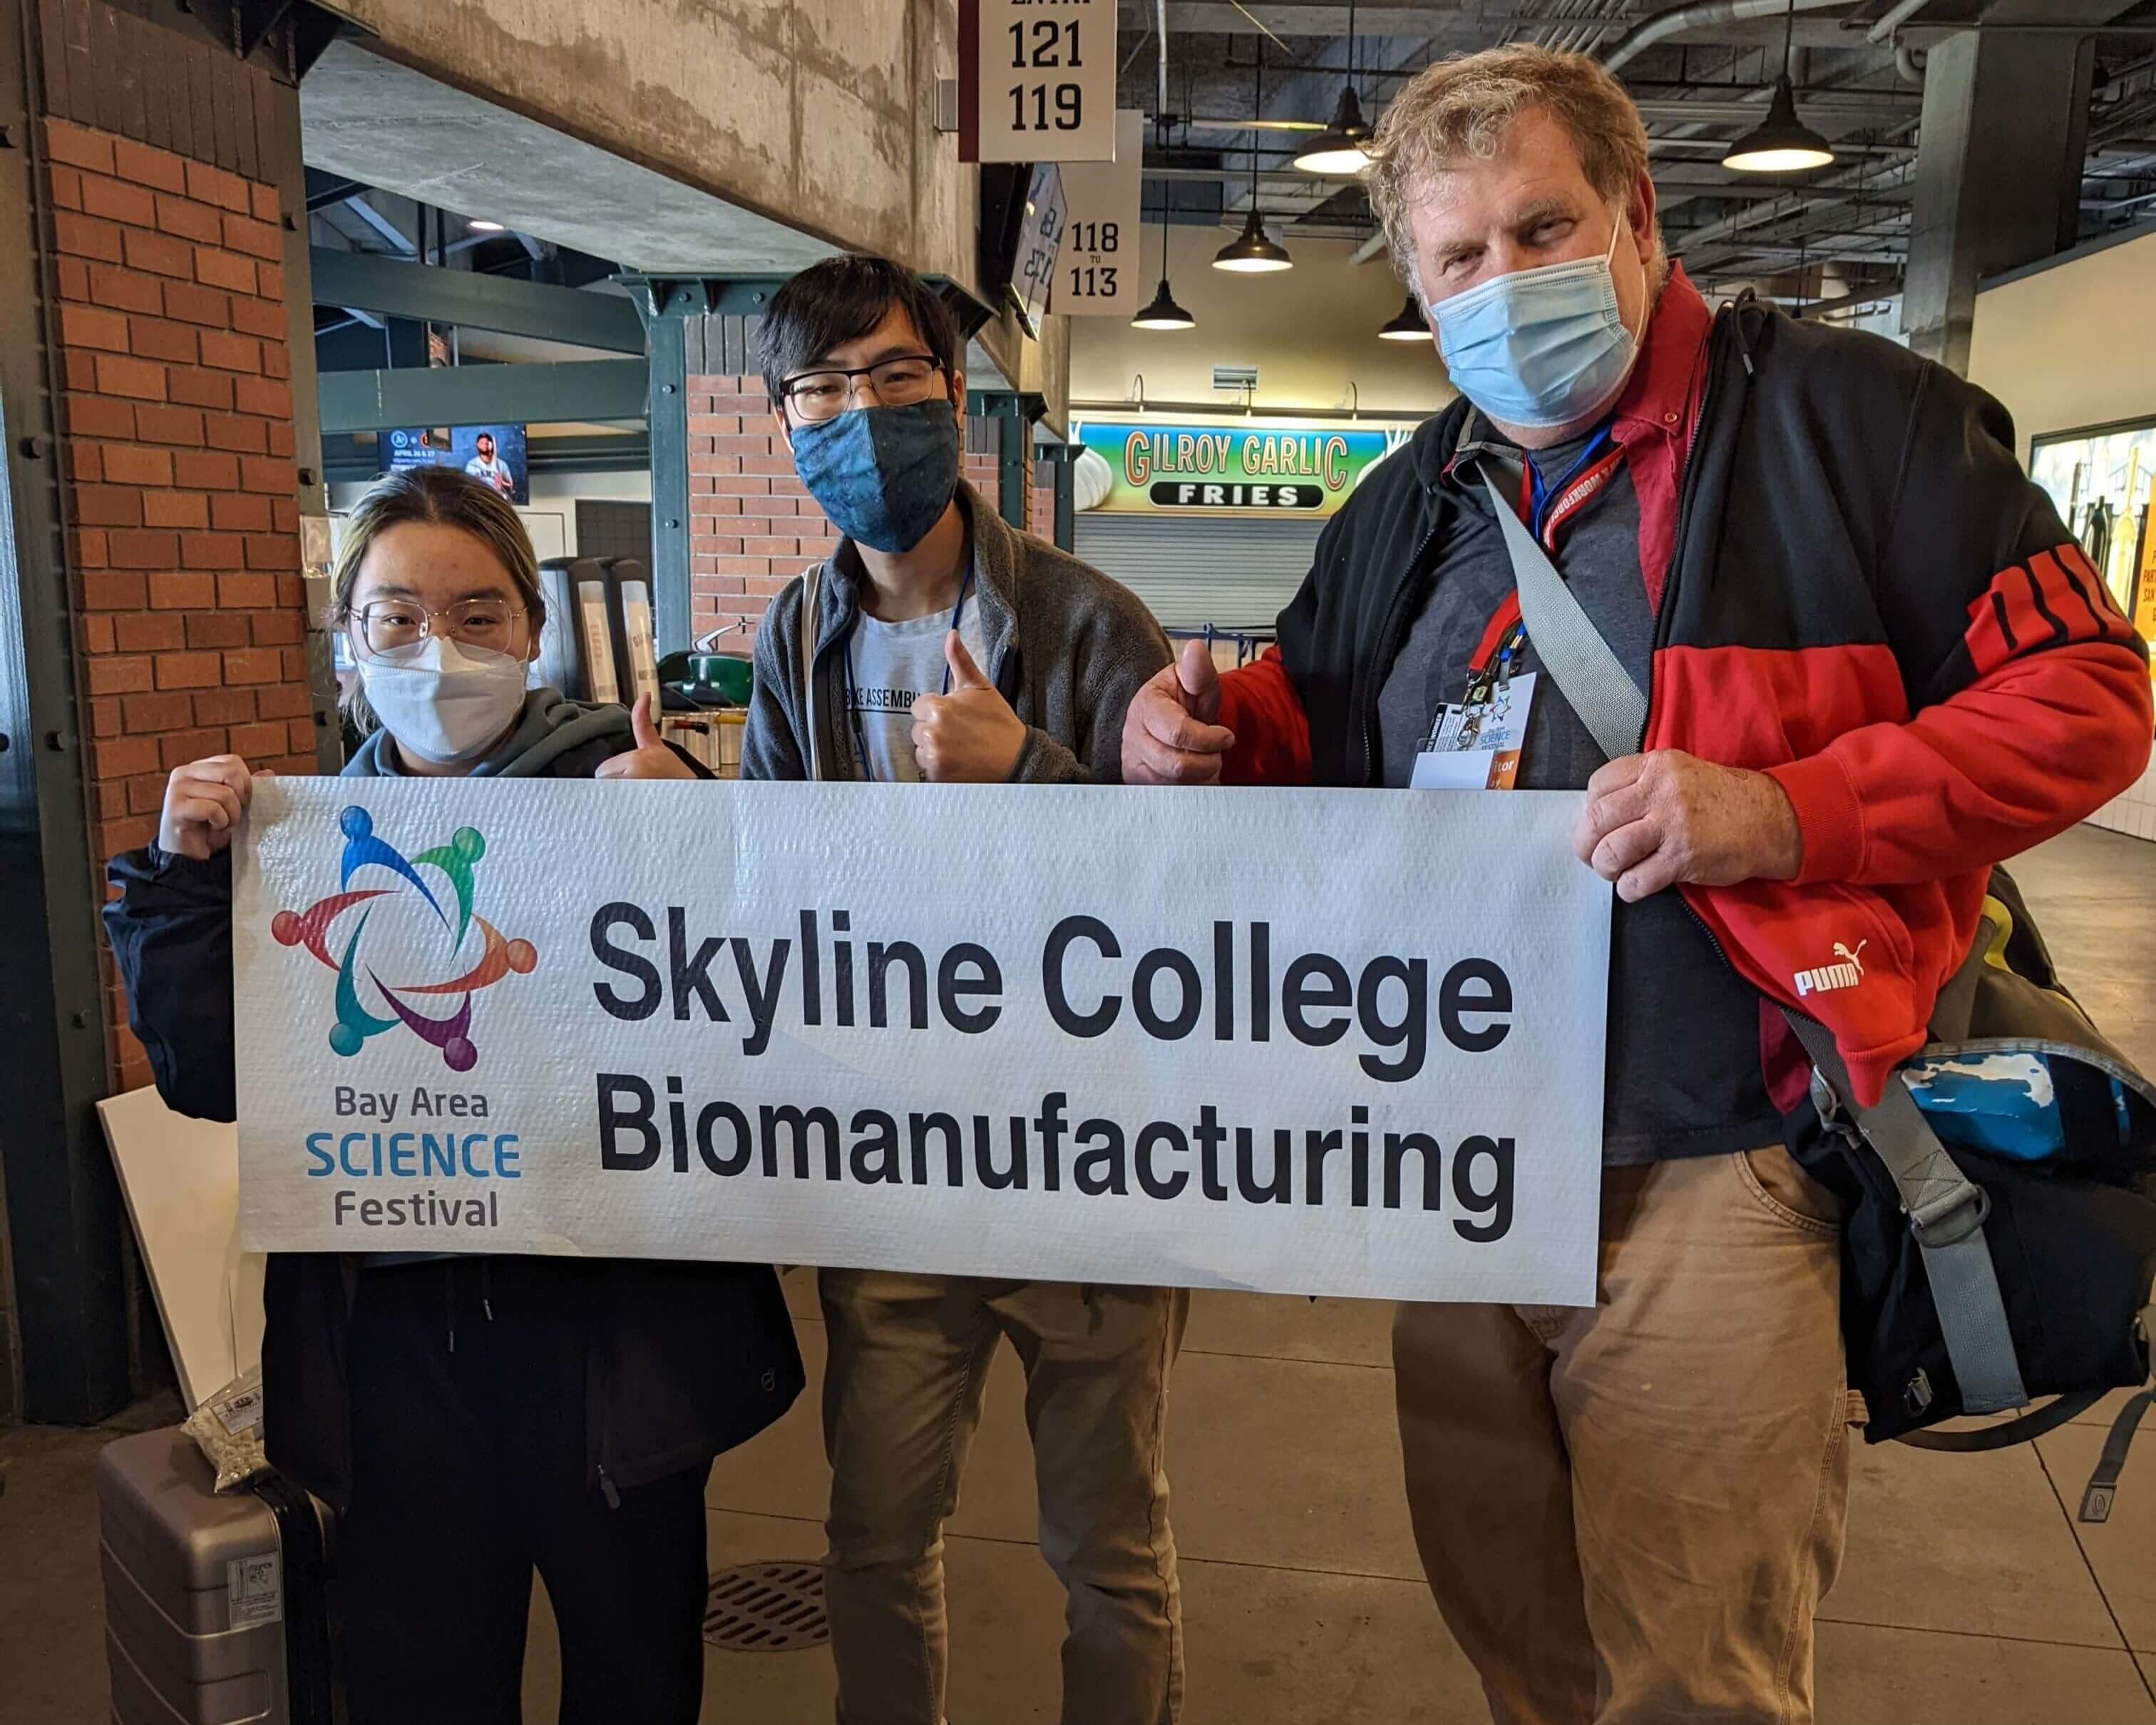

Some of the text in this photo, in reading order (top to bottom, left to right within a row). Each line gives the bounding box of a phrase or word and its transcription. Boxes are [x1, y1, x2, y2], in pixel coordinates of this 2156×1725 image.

[1009, 20, 1082, 68] 121
[1009, 83, 1082, 130] 119
[1071, 222, 1119, 252] 118
[1090, 255, 1101, 263] TO
[1070, 266, 1118, 297] 113
[1125, 430, 1348, 491] GILROY GARLIC
[1179, 484, 1298, 506] FRIES
[845, 688, 863, 706] BKE
[590, 901, 1513, 1082] Skyline College
[1794, 963, 1859, 996] PUMA
[335, 1085, 489, 1124] Bay Area
[305, 1132, 521, 1178] SCIENCE
[596, 1072, 1516, 1243] Biomanufacturing
[334, 1189, 498, 1227] Festival
